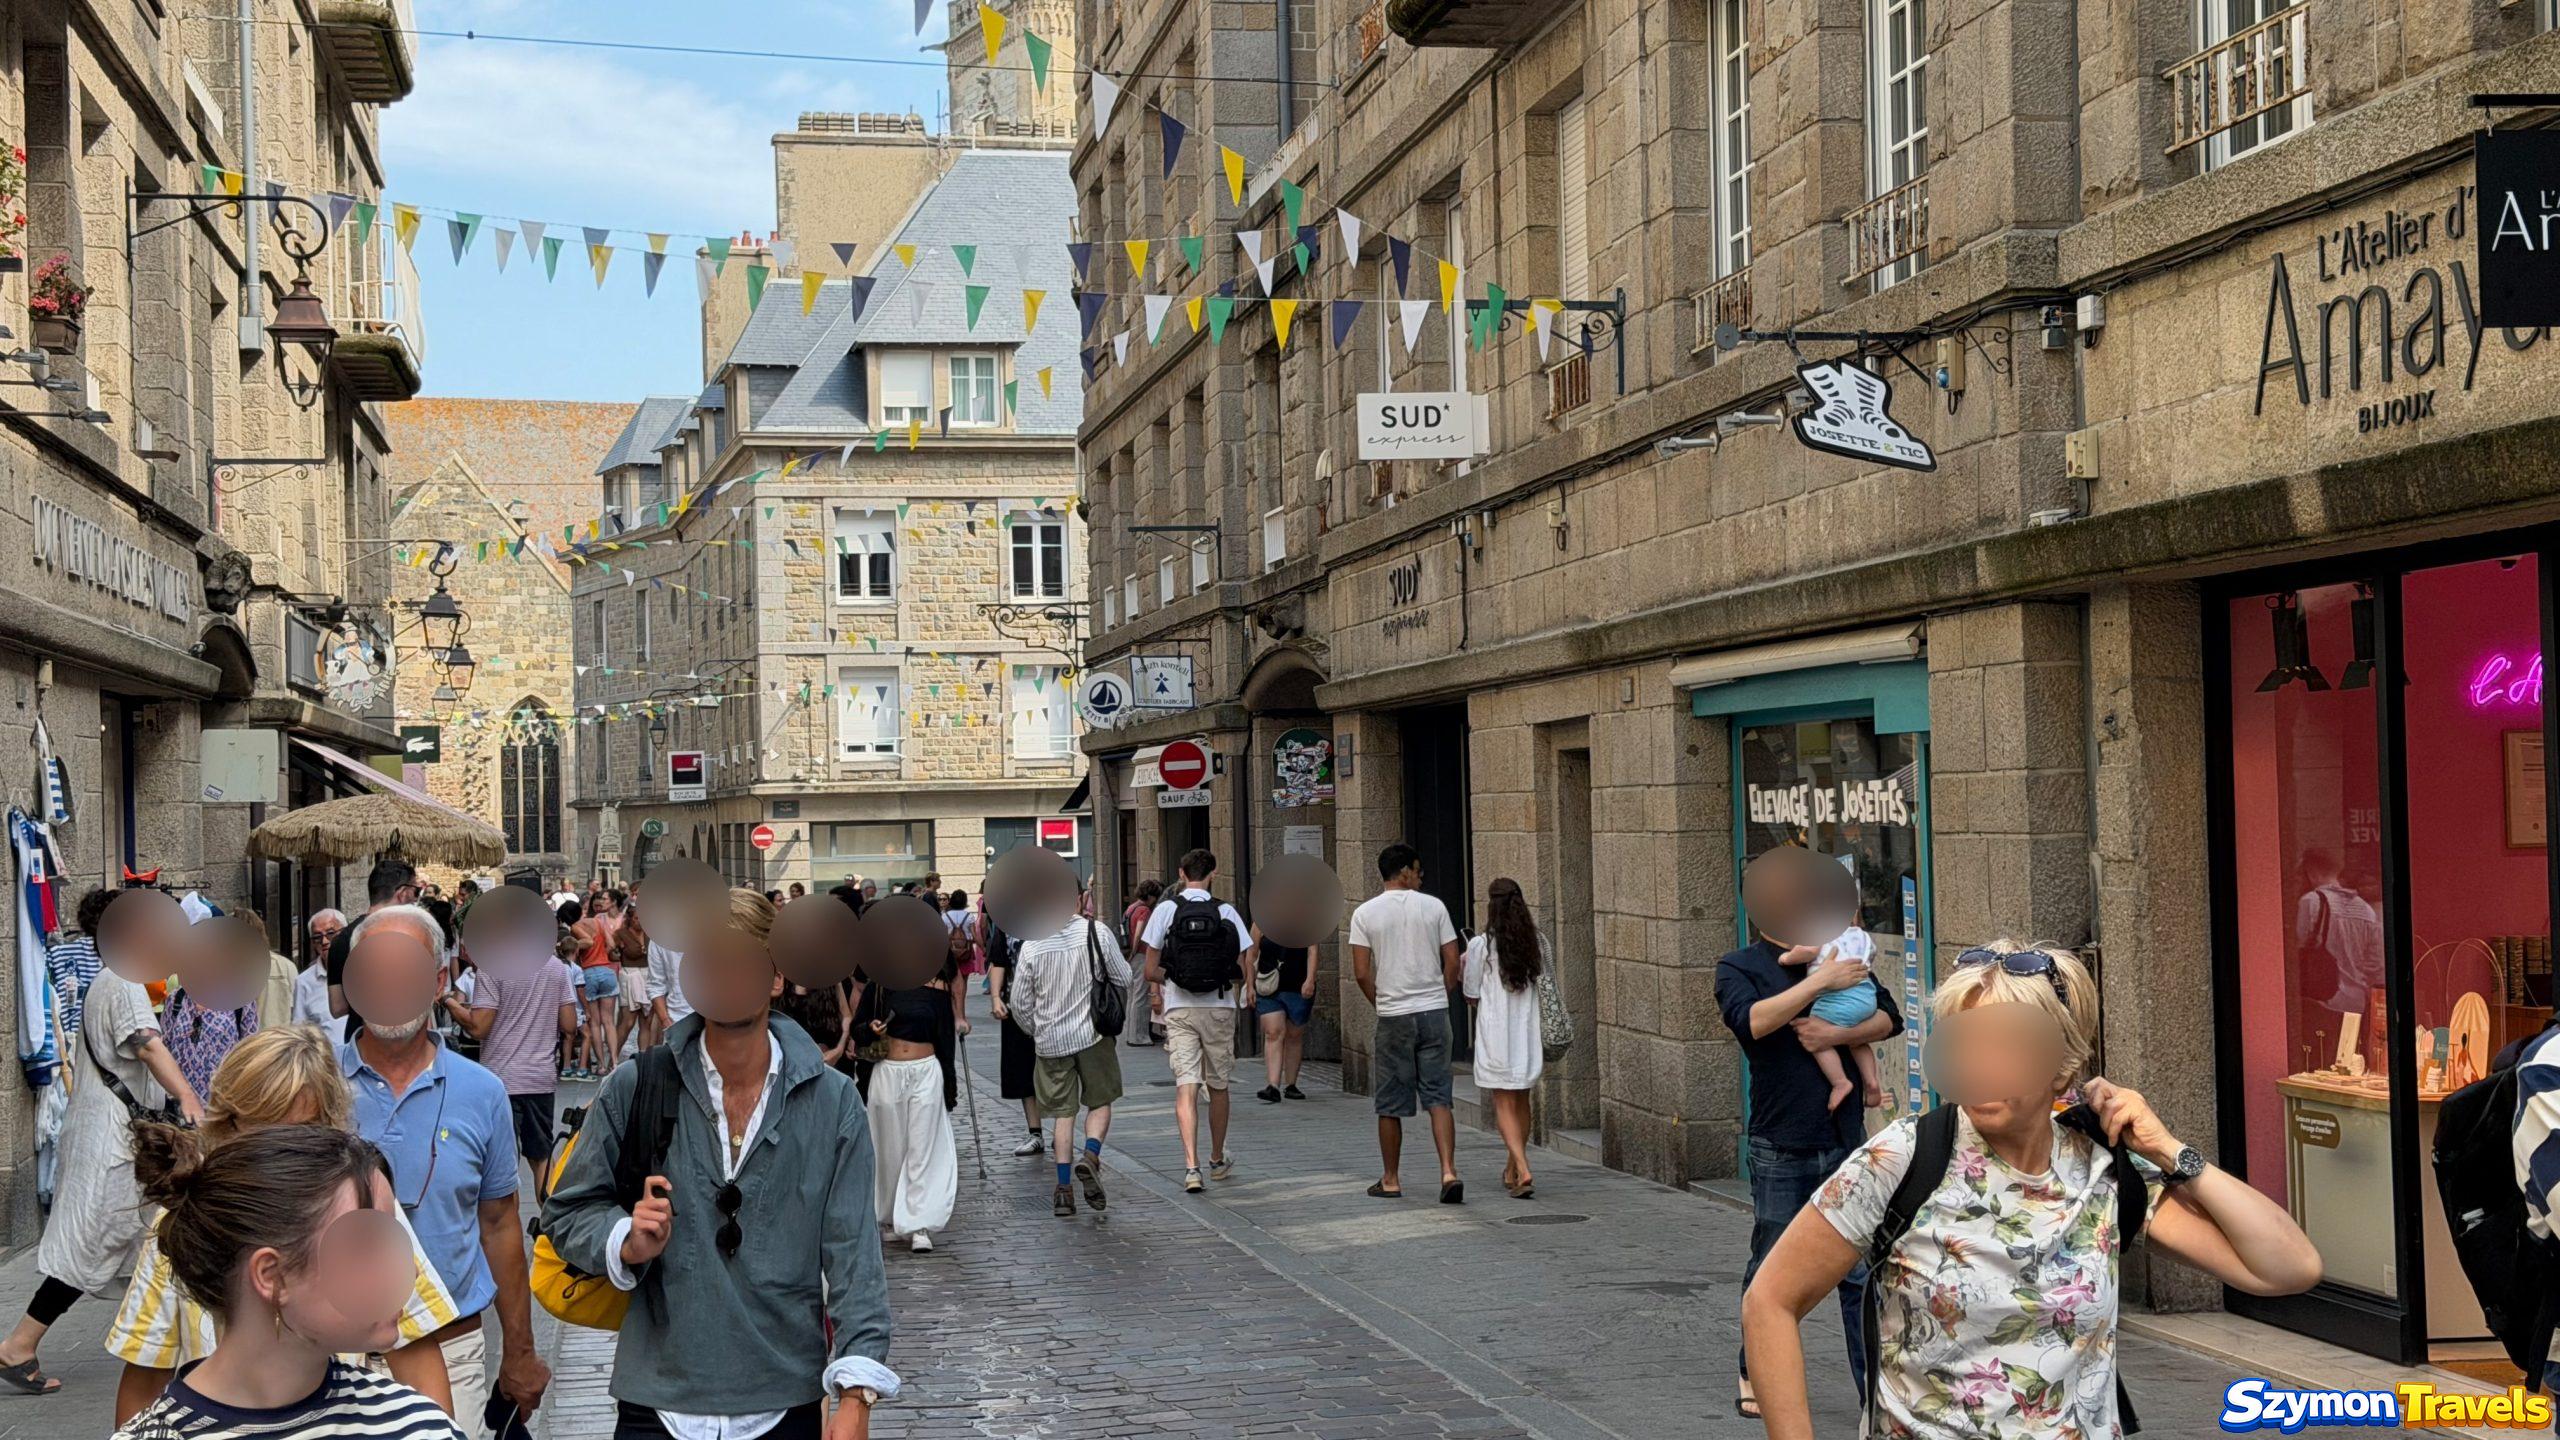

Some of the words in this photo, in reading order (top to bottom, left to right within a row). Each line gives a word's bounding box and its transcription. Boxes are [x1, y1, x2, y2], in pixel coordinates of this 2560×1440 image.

[2317, 210, 2435, 283] L'Atelier
[2444, 185, 2475, 240] d'
[2254, 251, 2552, 417] Amay
[2358, 389, 2436, 434] BIJOUX
[1367, 432, 1466, 449] express
[1809, 425, 1881, 451] JOSETTE
[1883, 441, 1895, 454] &
[1895, 445, 1925, 460] TIC
[1082, 705, 1102, 723] PETIT
[1161, 794, 1186, 804] SAUF
[1748, 783, 1811, 828] ELEVAGE
[1813, 787, 1838, 825] DE
[1840, 778, 1908, 827] JOSETTES
